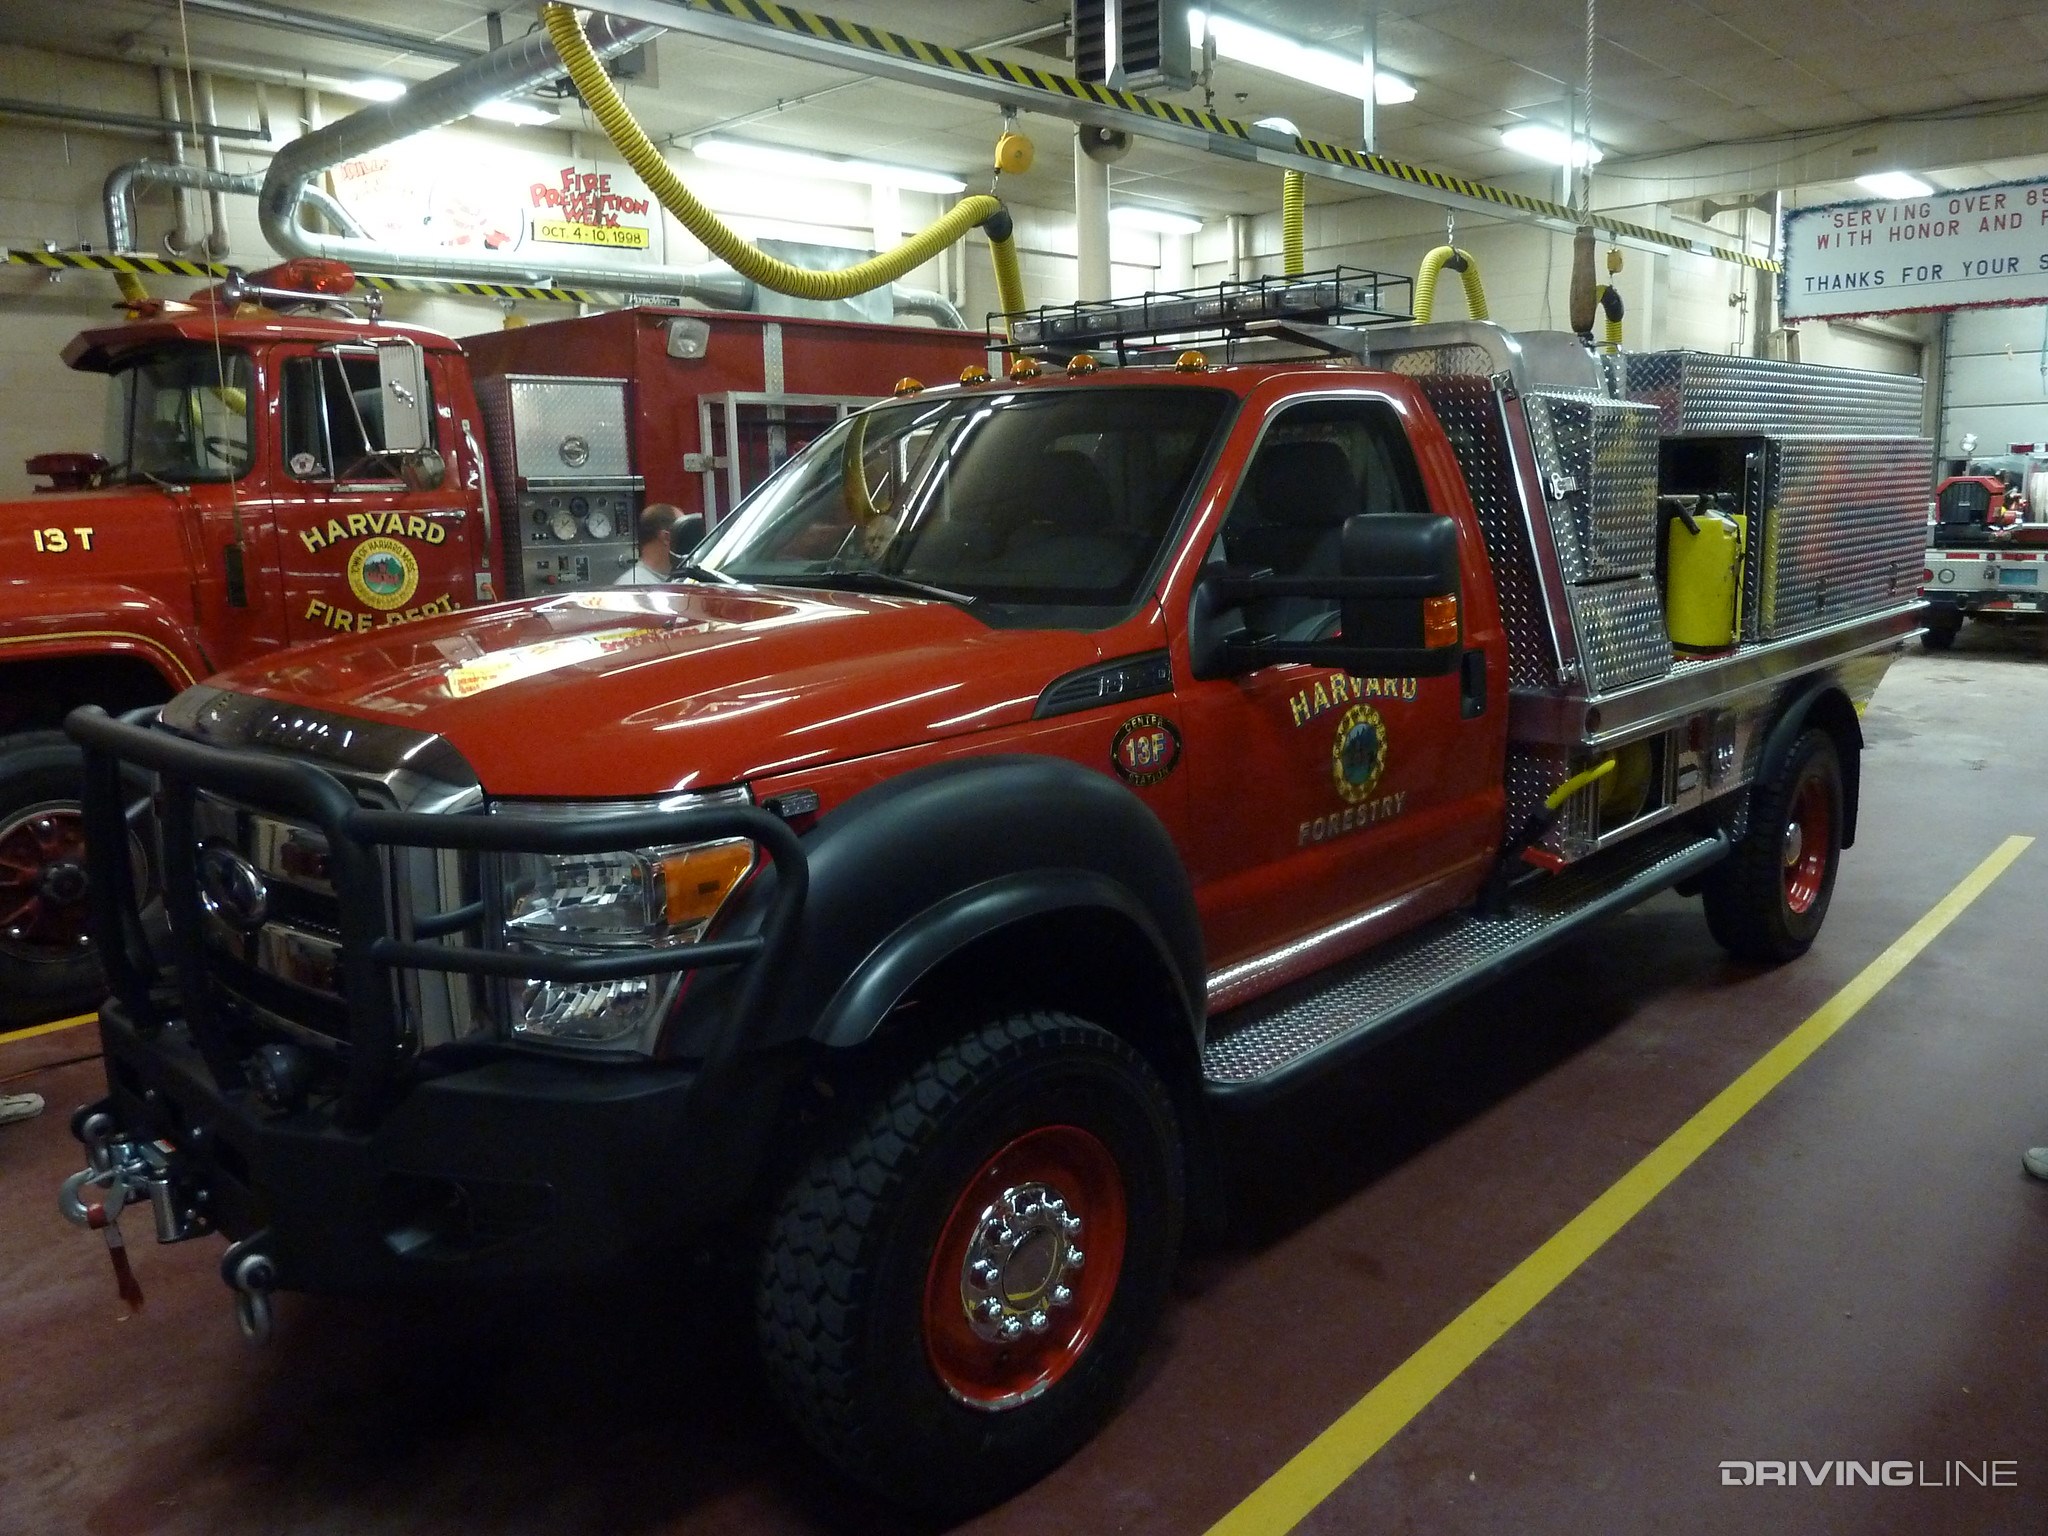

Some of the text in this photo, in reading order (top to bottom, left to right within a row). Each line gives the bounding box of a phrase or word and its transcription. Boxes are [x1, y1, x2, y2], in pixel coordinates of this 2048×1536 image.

[560, 166, 612, 193] FIRE
[529, 183, 650, 216] PREVENTION
[1949, 193, 2007, 215] OVER
[613, 231, 642, 244] 1998
[1816, 229, 1873, 250] WITH
[1889, 219, 1960, 243] HONOR
[1979, 212, 2023, 233] AND
[1805, 270, 1885, 292] THANKS
[1902, 264, 1943, 284] FOR
[1963, 257, 2019, 277] YOUR
[33, 527, 94, 553] 13 T
[300, 512, 447, 554] HARVARD
[367, 539, 403, 555] HARVARD
[304, 598, 374, 634] FIRE
[1289, 672, 1418, 728] HARVARD
[1124, 715, 1164, 733] CENTER
[1125, 732, 1168, 768] 13F
[1127, 767, 1170, 786] STATION
[1298, 790, 1407, 847] FORESTRY
